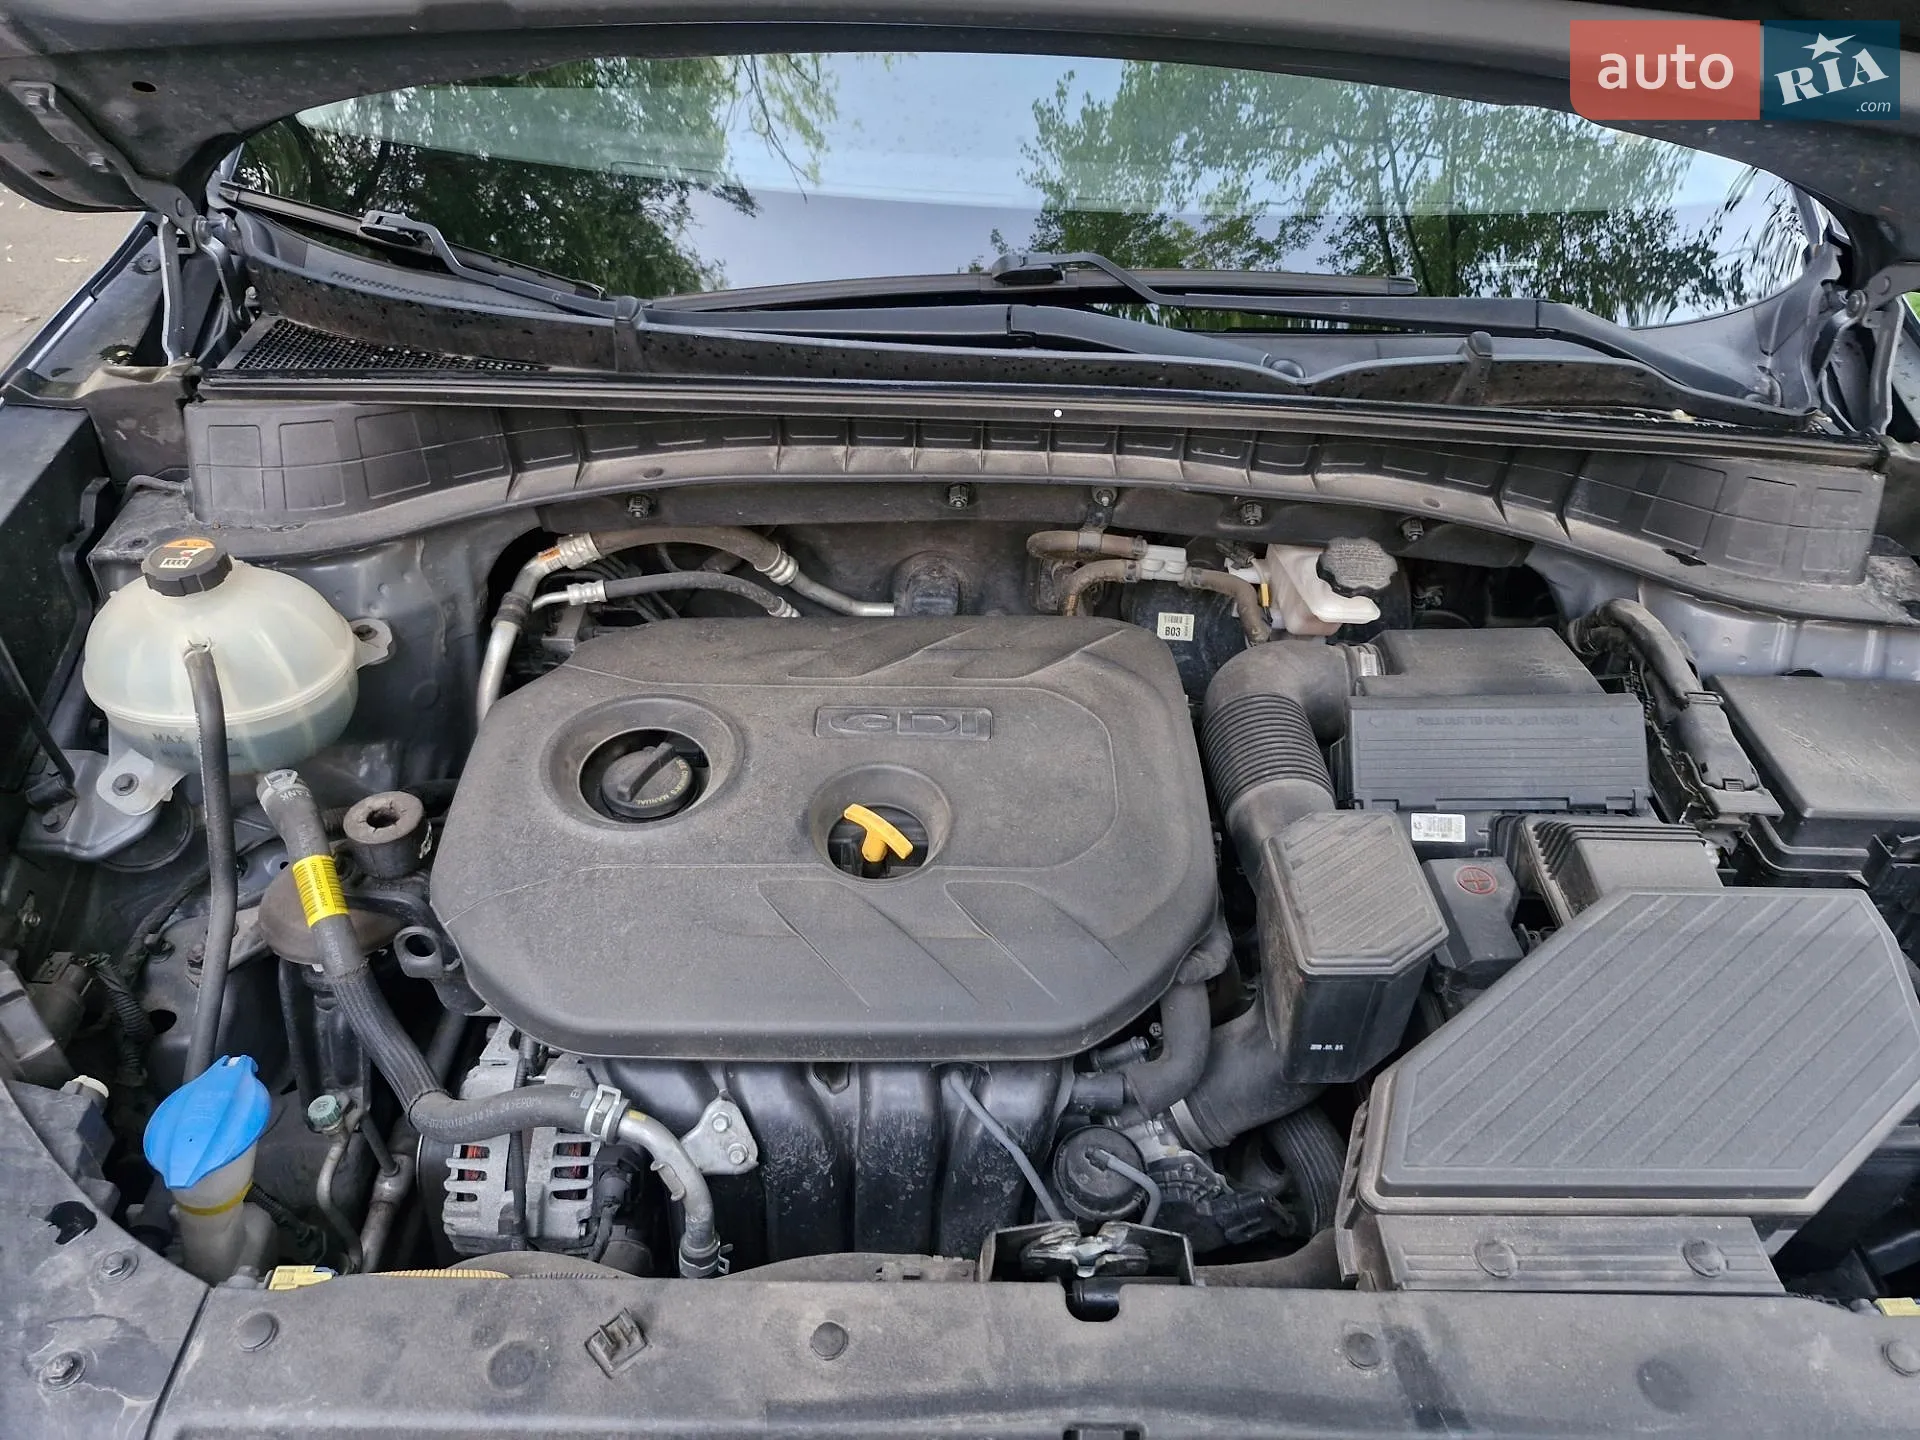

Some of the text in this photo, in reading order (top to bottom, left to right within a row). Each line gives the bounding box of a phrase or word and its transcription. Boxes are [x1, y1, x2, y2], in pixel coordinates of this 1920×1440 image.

[1165, 626, 1181, 637] B03
[829, 712, 979, 737] GDI
[152, 732, 185, 744] MAX
